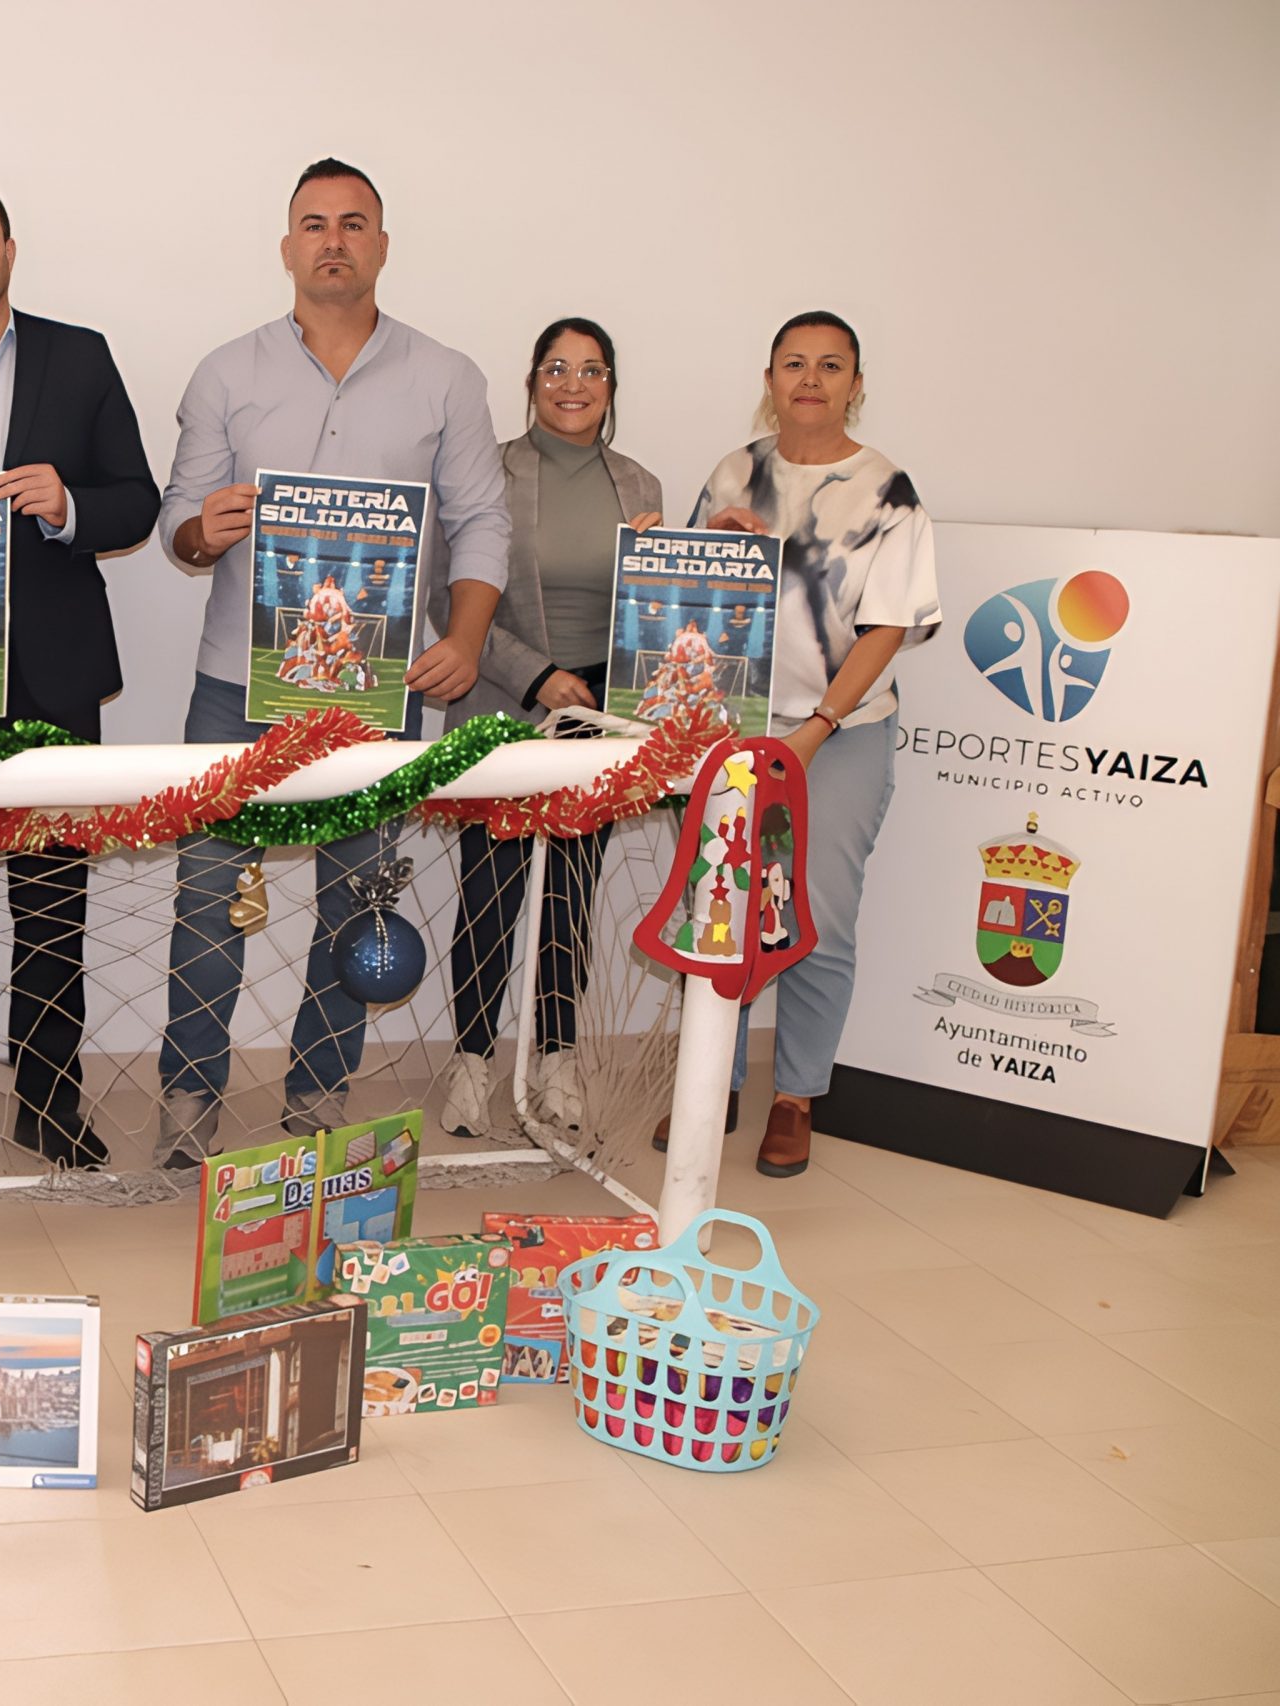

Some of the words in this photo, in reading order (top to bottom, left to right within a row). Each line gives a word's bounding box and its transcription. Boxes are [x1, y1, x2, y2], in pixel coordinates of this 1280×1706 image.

[273, 484, 409, 513] PORTERÍA
[259, 503, 417, 533] SOLIDARIA
[634, 536, 765, 561] PORTERÍA
[622, 555, 775, 581] SOLIDARIA
[936, 770, 1049, 796] MUNICIPIO
[1060, 786, 1144, 808] ACTIVO
[934, 1016, 1088, 1064] Ayuntamiento
[956, 1048, 983, 1068] de
[990, 1053, 1057, 1084] YAIZA
